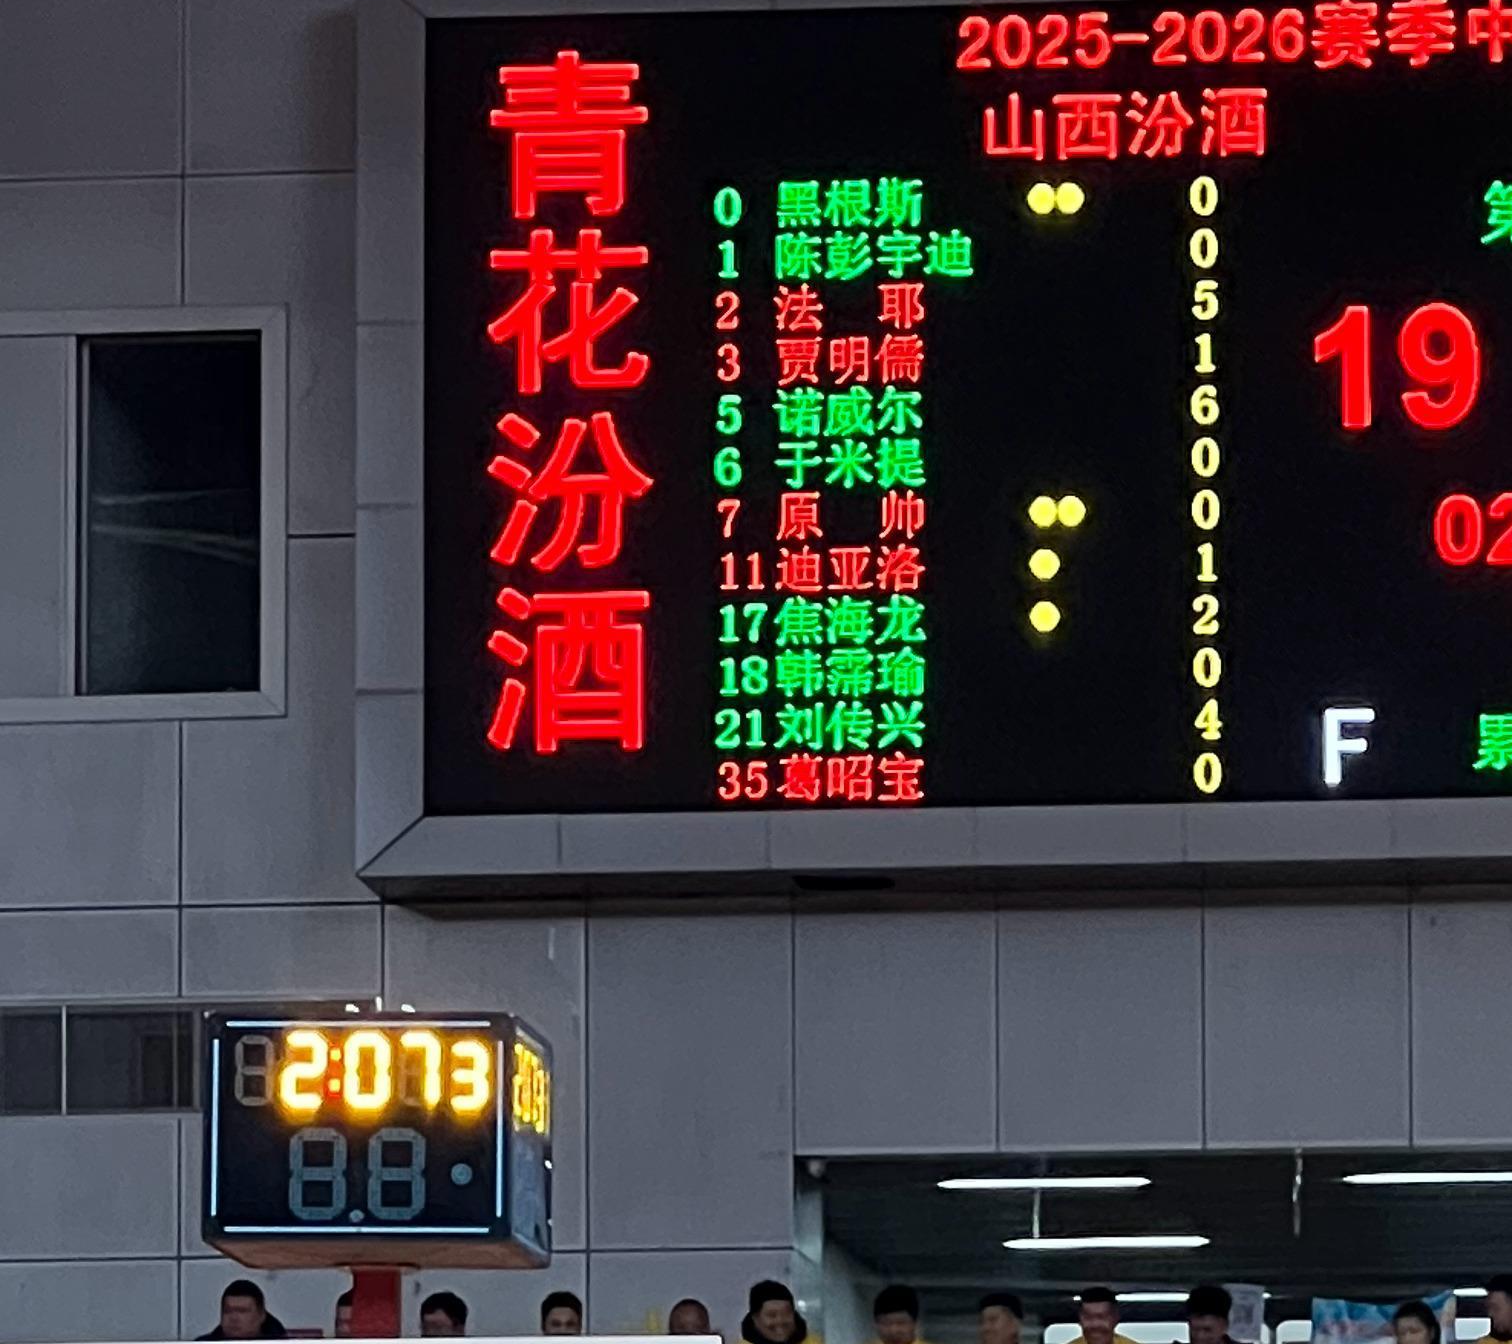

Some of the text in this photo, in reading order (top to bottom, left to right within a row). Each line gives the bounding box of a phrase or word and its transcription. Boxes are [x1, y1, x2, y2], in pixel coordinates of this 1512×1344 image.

[984, 87, 1269, 163] 山西汾酒
[714, 176, 1218, 228] 0 黑根斯 0
[719, 228, 1218, 281] 1 陈彭宇迪 0
[716, 291, 739, 329] 2
[1192, 280, 1218, 320] 5
[718, 333, 1215, 386] 3 贾明儒 1
[1313, 302, 1481, 428] 19
[488, 50, 654, 753] 青花汾酒
[717, 385, 1219, 436] 5 诺威尔 6
[714, 437, 1219, 488] 6 于米提 0
[718, 499, 740, 537] 7
[1192, 490, 1219, 530] 0
[721, 543, 1217, 593] 11 迪亚洛 1
[719, 594, 1219, 645] 17 焦海龙 2
[720, 656, 768, 696] 18
[1193, 647, 1221, 687] 0
[715, 699, 1222, 750] 21 刘传兴 4
[1321, 707, 1376, 788] F
[719, 751, 1221, 802] 35 葛昭宝 0
